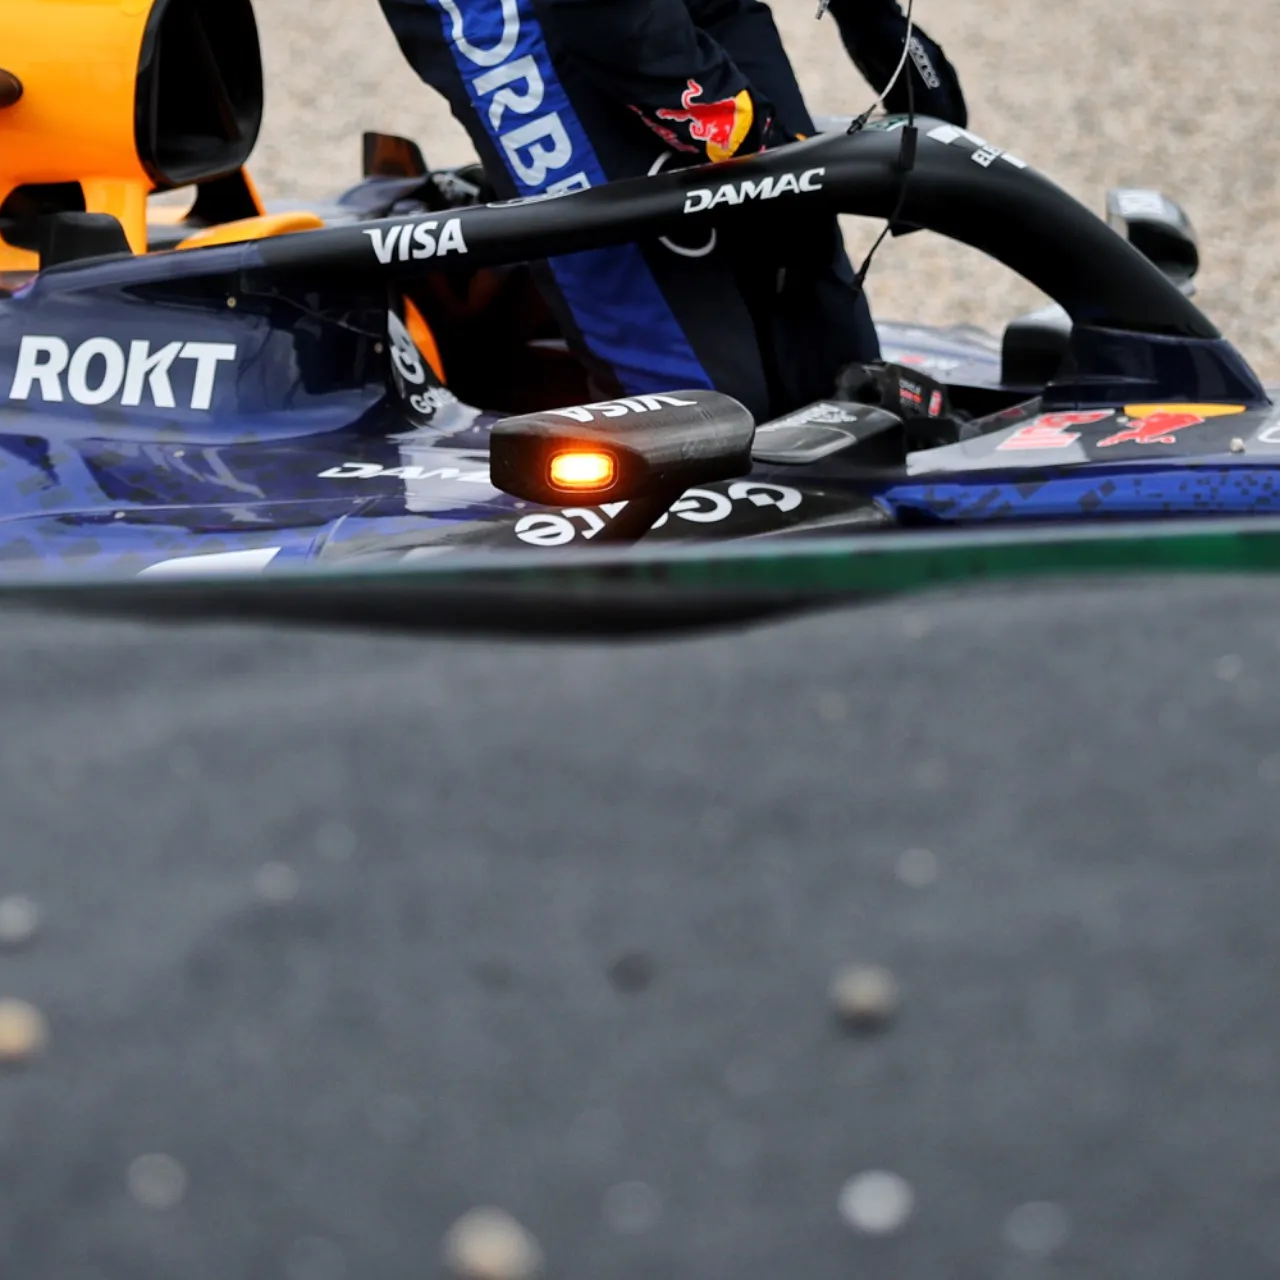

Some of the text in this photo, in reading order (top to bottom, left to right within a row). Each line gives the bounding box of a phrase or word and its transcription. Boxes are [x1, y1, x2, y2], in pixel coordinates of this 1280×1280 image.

[683, 167, 825, 214] DAMAC
[363, 218, 467, 264] VISA
[9, 335, 237, 411] ROKT
